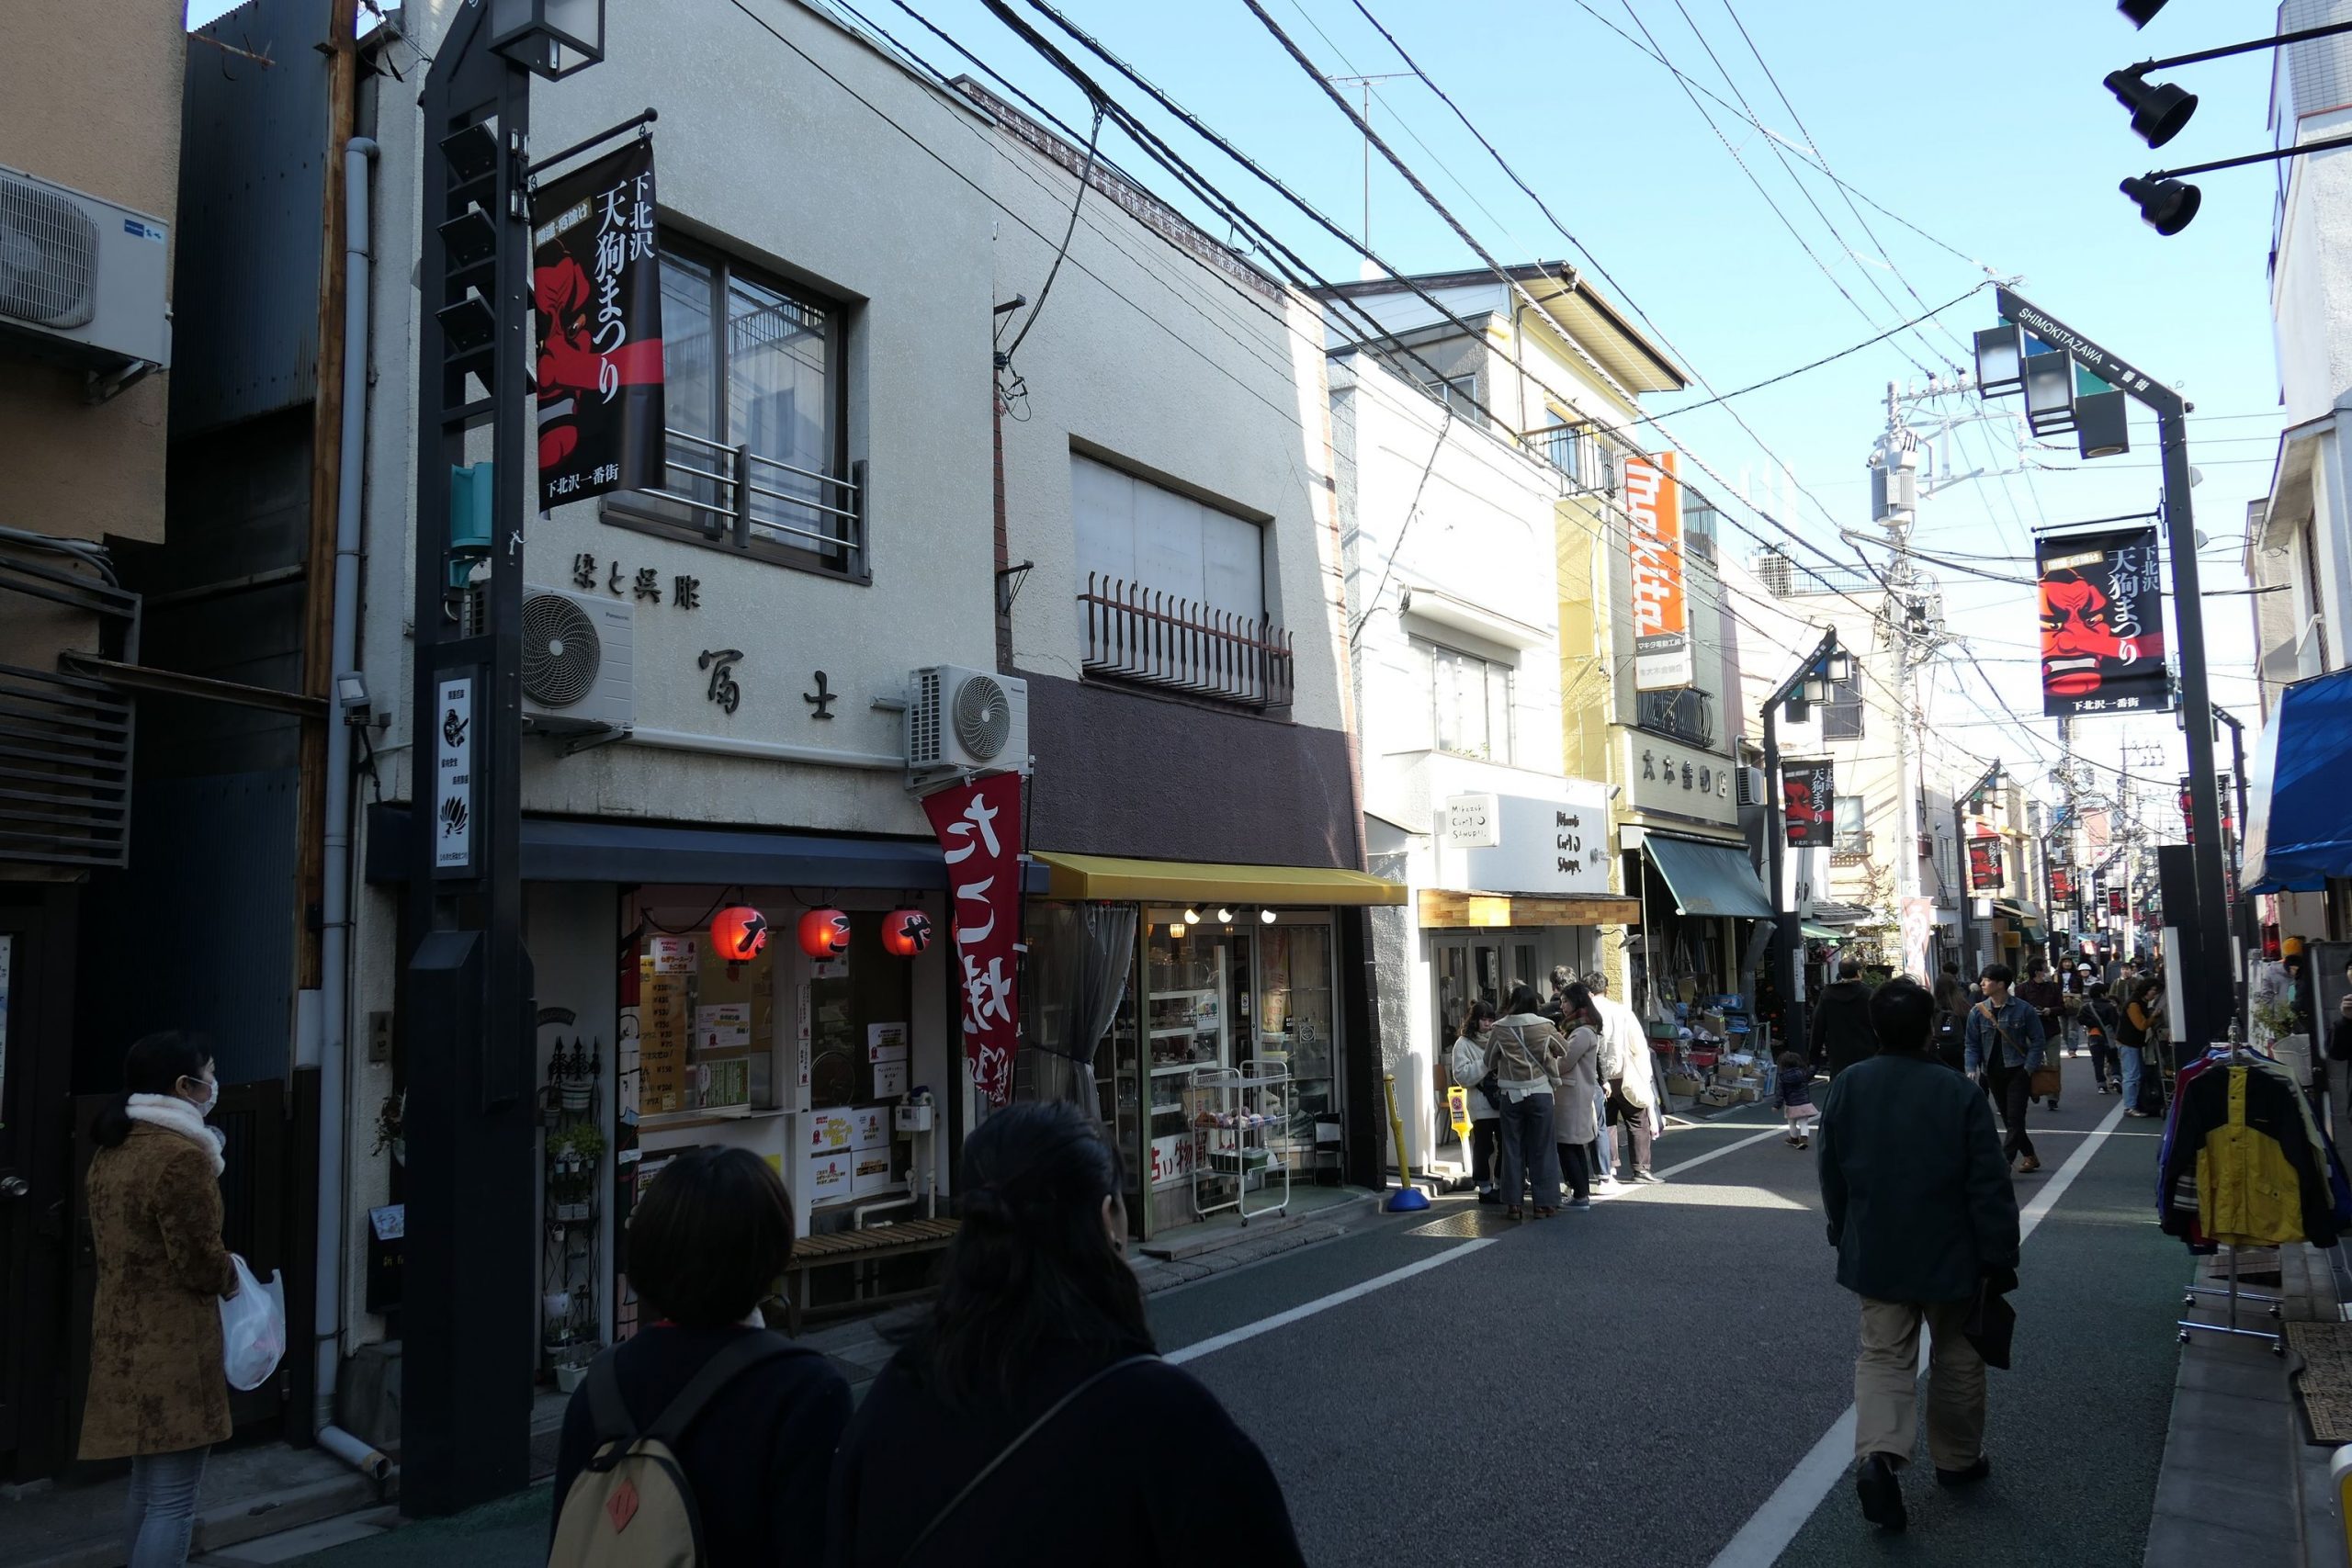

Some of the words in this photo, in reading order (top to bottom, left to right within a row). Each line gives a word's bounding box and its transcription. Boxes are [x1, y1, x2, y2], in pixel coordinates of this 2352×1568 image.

[629, 172, 655, 261] 下北沢
[594, 180, 627, 405] 天狗まつり
[2018, 306, 2104, 366] SHIMOKITAZAWA
[2109, 362, 2151, 392] 一番街
[546, 462, 619, 498] 下北沢一番街
[572, 552, 702, 610] 染と呉服
[1628, 462, 1670, 637] makita
[2142, 546, 2160, 592] 下北沢
[2107, 547, 2143, 667] 天狗まつり
[2072, 695, 2140, 712] 下北沢一番街
[1811, 768, 1826, 826] 天狗まつり
